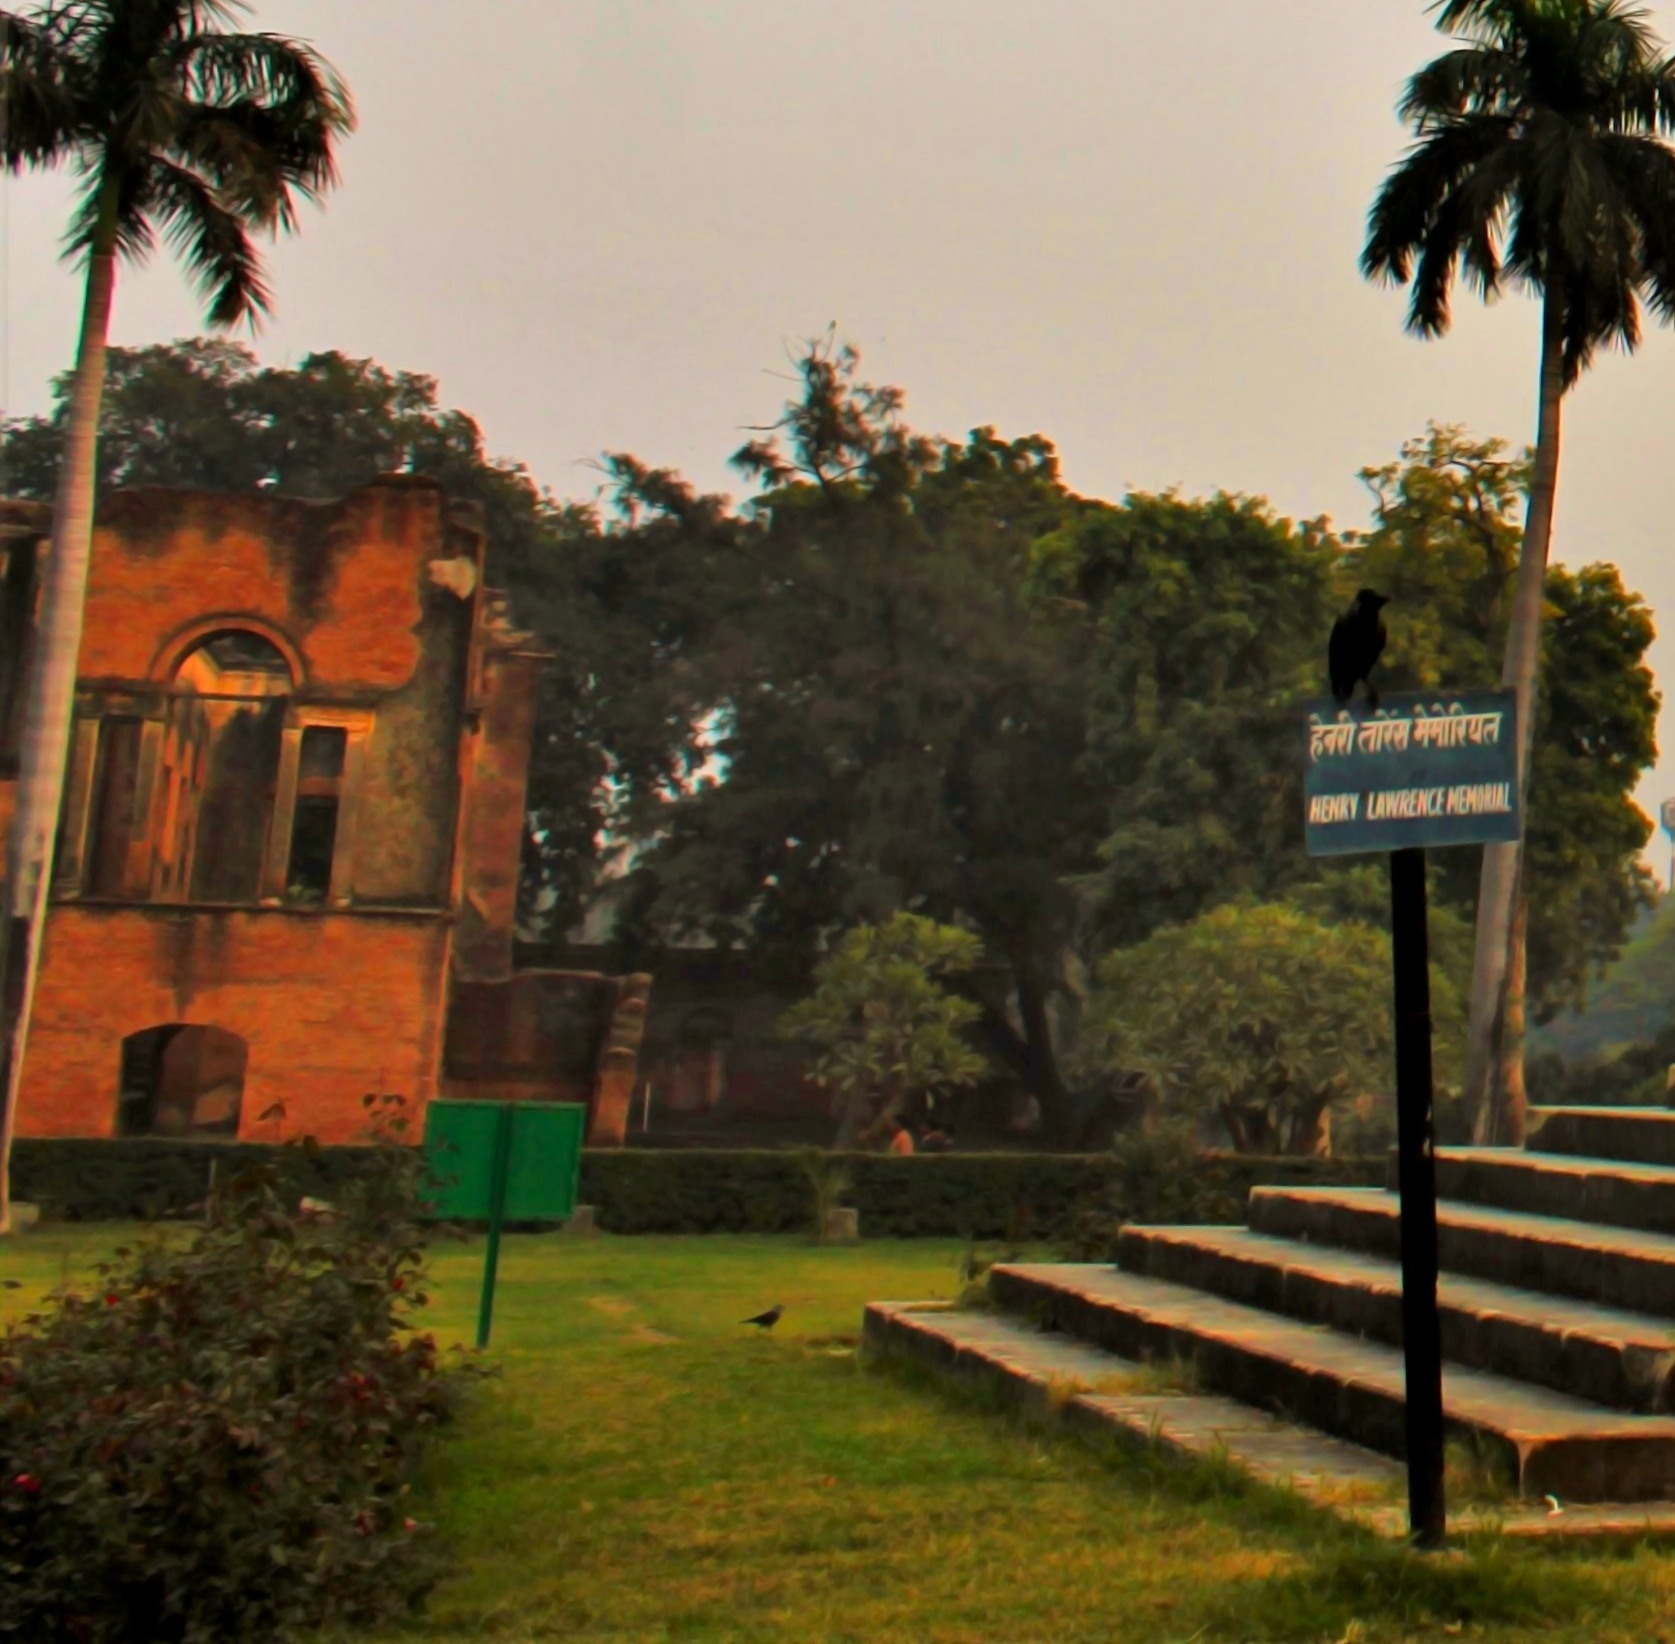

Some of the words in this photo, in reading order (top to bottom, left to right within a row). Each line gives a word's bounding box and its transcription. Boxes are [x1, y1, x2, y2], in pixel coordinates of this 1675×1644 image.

[1308, 792, 1360, 824] HENRY
[1366, 787, 1446, 821] LAWRENCE
[1446, 782, 1513, 814] MEMORIAL
